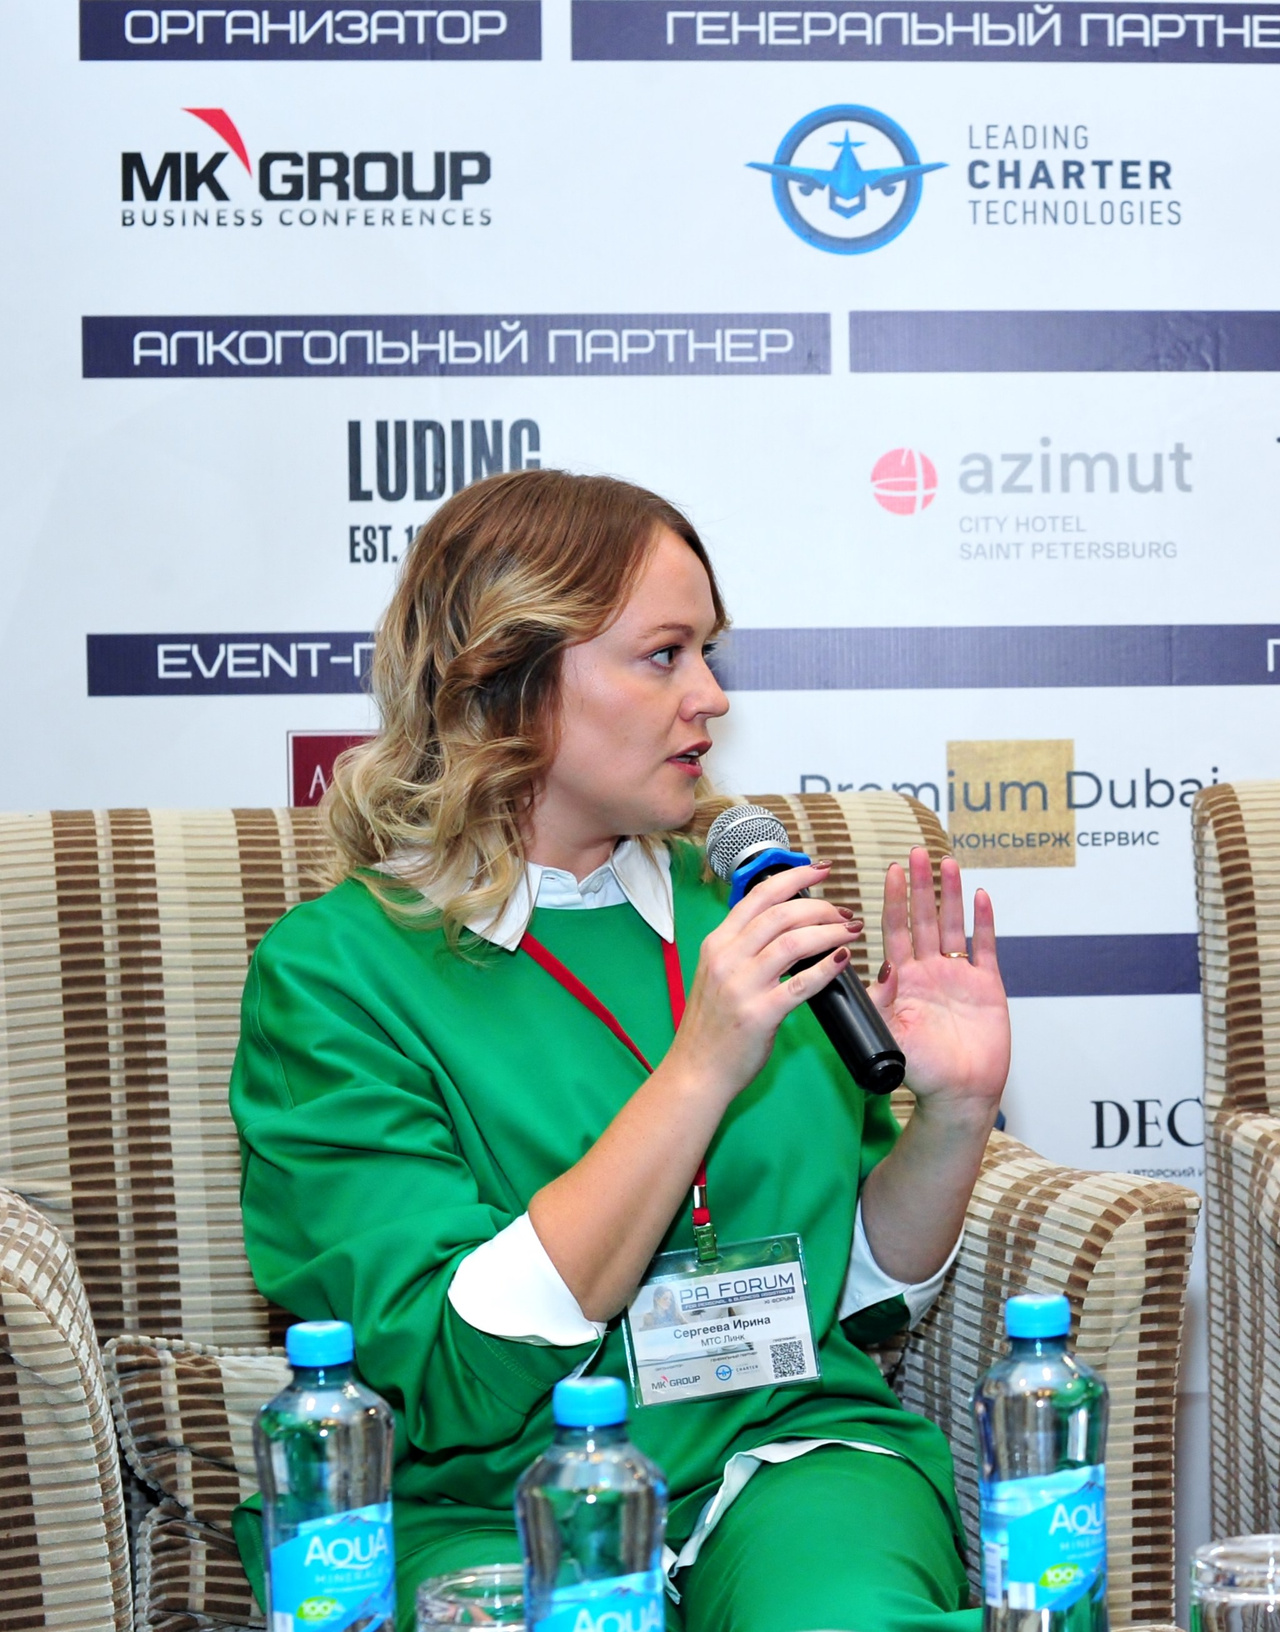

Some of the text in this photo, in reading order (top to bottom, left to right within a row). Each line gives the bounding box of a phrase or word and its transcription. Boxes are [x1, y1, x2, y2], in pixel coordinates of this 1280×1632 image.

[125, 8, 507, 45] ОРГАНИЗАТОР
[667, 4, 1061, 47] ГЕНЕРАЛЬНЫЙ
[968, 124, 1090, 150] LEADING
[121, 151, 492, 201] MK GROUP
[967, 160, 1173, 190] CHARTER
[121, 208, 493, 227] BUSINESS CONFERENCES
[969, 199, 1183, 226] TECHNOLOGIES
[133, 321, 794, 366] АЛКОГОЛЬНЫЙ ПАРТНЕР
[958, 436, 1194, 494] azimut
[958, 515, 1087, 534] CITY HOTEL
[349, 524, 398, 563] EST.
[958, 541, 1178, 561] SAINT PETERSBURG
[1076, 830, 1160, 847] СЕРВИС
[679, 1272, 795, 1303] PA FORUM
[673, 1315, 771, 1340] Сергеева Ирина
[701, 1333, 746, 1348] МТС Линк
[669, 1375, 701, 1387] GROUP
[304, 1527, 388, 1570] AQUA
